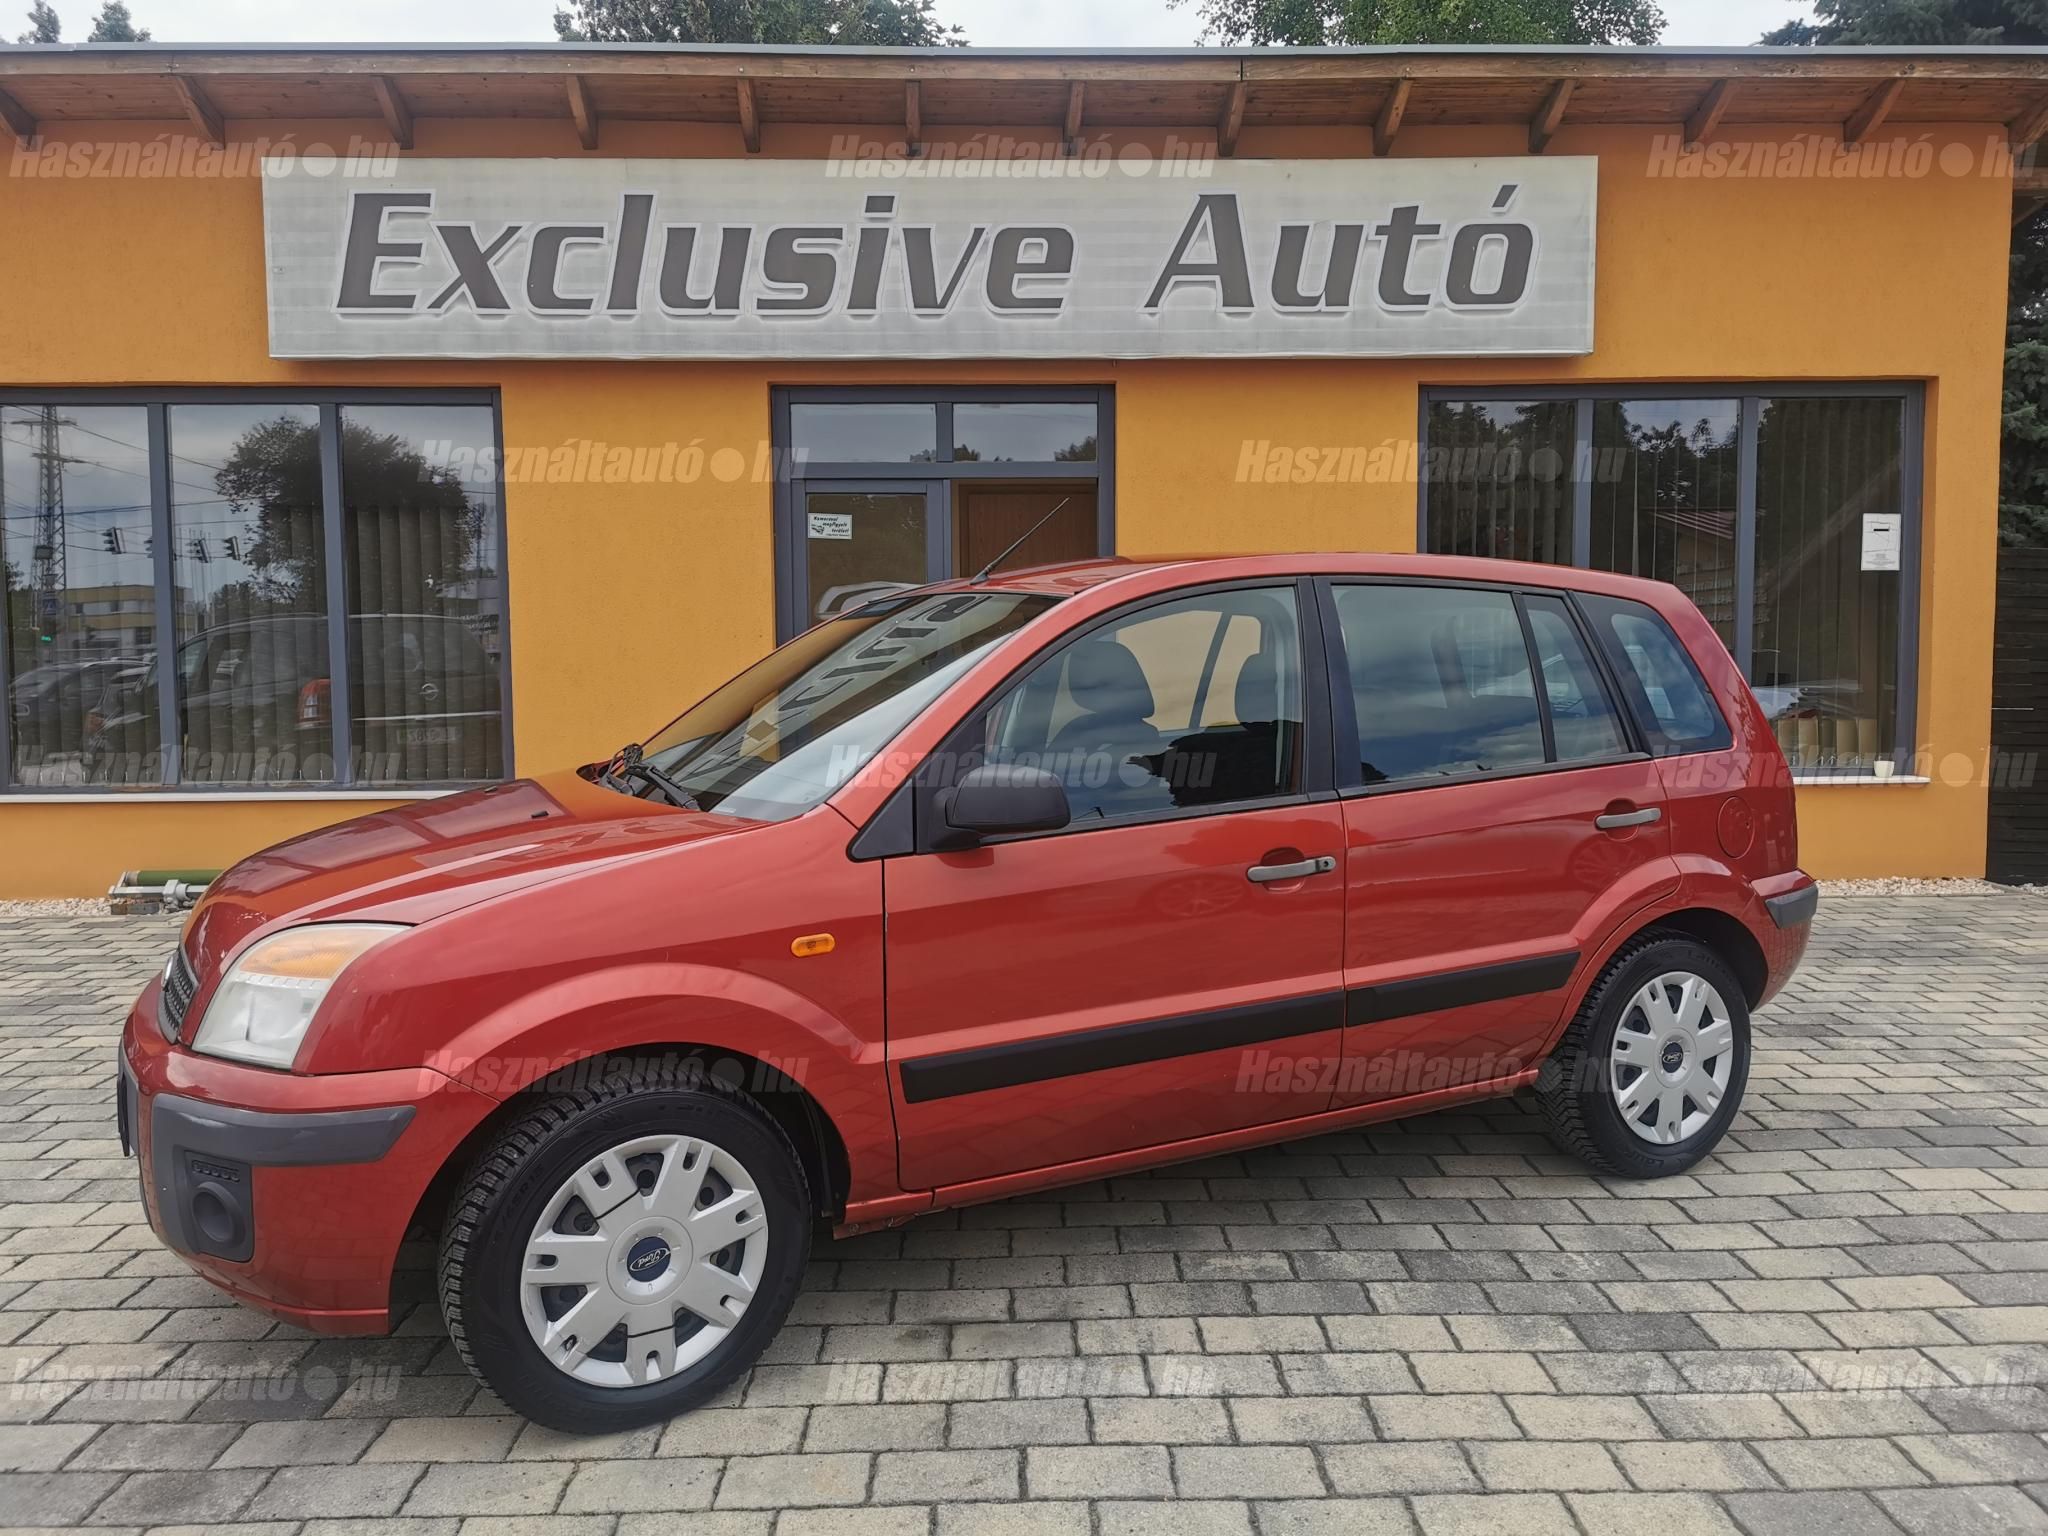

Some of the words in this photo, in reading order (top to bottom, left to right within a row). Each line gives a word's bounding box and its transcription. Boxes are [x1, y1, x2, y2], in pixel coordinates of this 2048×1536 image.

[333, 188, 1079, 317] Exclusive
[1142, 183, 1537, 317] Autó
[635, 1249, 664, 1269] Ford
